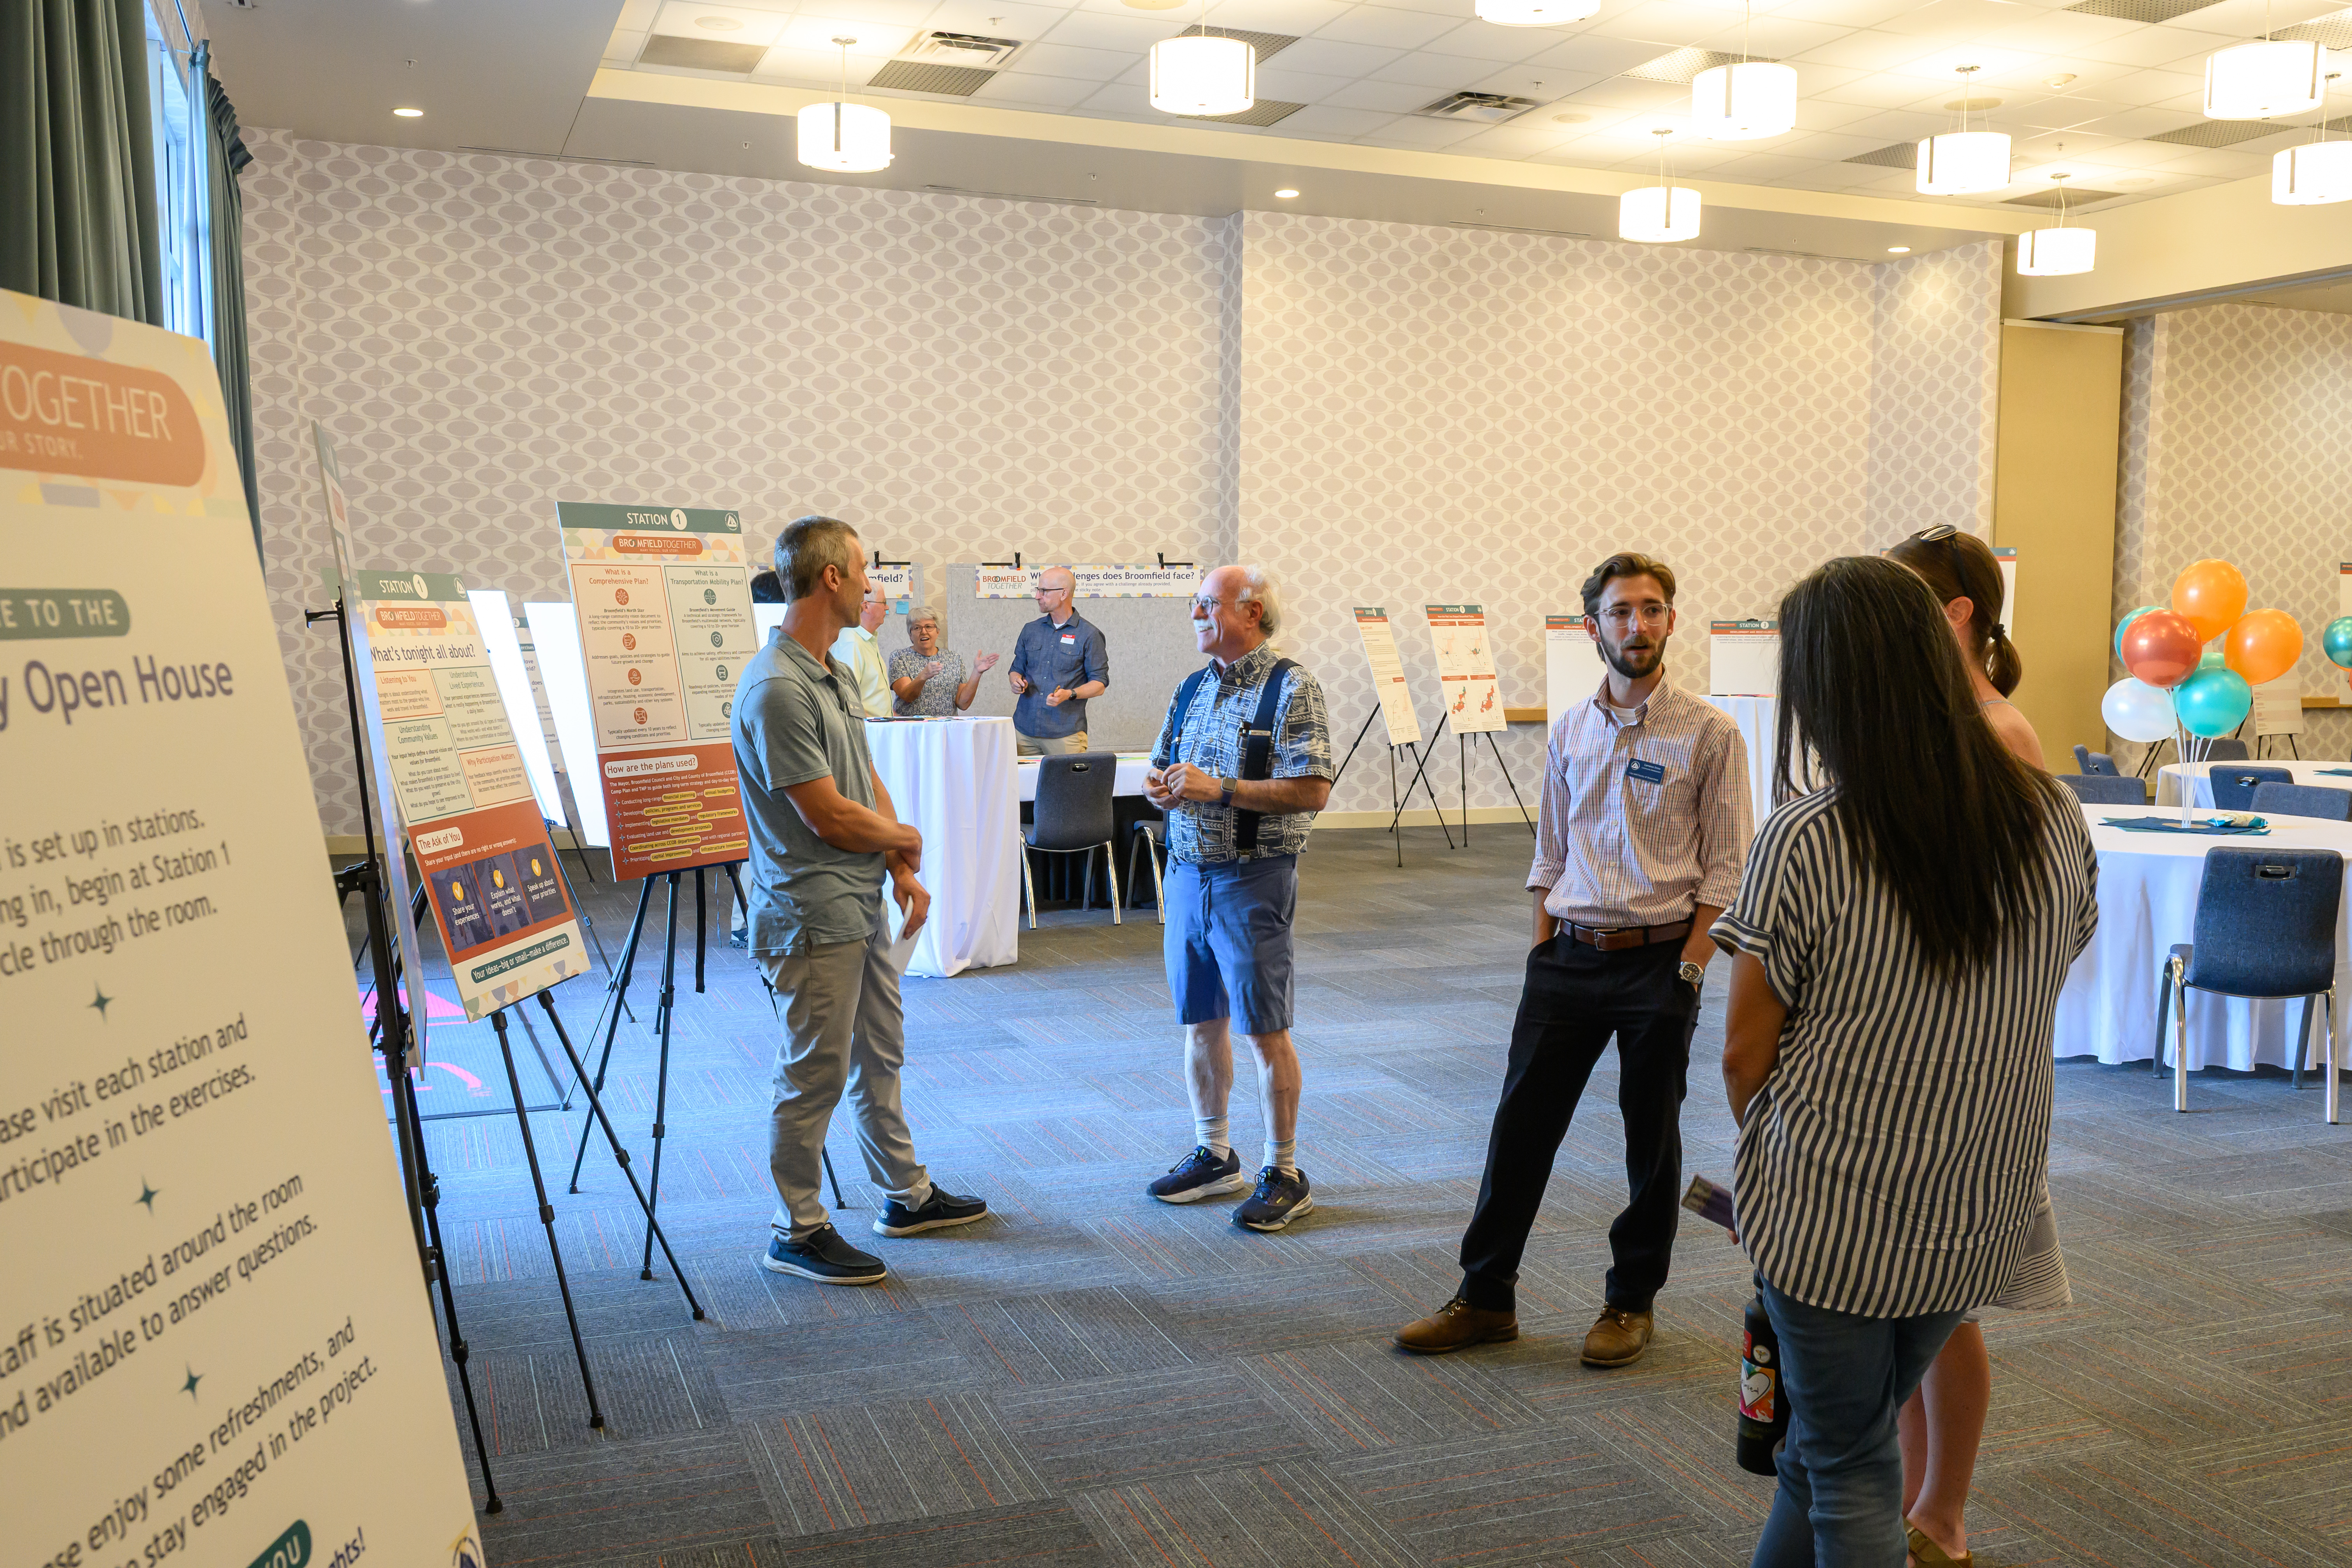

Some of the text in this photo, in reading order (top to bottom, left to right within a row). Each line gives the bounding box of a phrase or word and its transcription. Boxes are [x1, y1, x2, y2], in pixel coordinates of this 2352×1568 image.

[2, 365, 171, 440] OGETHER
[25, 433, 82, 459] STORY.
[627, 513, 681, 525] STATION 1
[379, 580, 413, 593] STATION
[25, 599, 60, 627] TO
[69, 599, 117, 625] THE
[401, 645, 435, 663] tonight
[436, 644, 448, 659] all
[448, 644, 475, 658] about?
[380, 676, 402, 685] Listening
[449, 670, 479, 679] Understanding
[24, 660, 127, 724] Open
[134, 656, 232, 702] House
[460, 681, 485, 690] Experiences
[398, 724, 432, 733] Understanding
[397, 735, 424, 744] Community
[466, 759, 476, 767] Why
[476, 756, 501, 765] Participation
[607, 765, 624, 774] How
[640, 762, 653, 771] the
[655, 761, 674, 772] plans
[676, 758, 695, 767] used?
[6, 809, 204, 868] is set up in stations.
[418, 839, 431, 850] The
[432, 836, 443, 847] Ask
[448, 832, 461, 842] You
[30, 885, 62, 915] in,
[65, 869, 124, 906] begin
[129, 863, 151, 890] at
[152, 849, 217, 883] Station
[220, 841, 230, 865] 1
[527, 882, 539, 893] Speak
[544, 878, 554, 887] about
[490, 886, 515, 900] Explain what
[531, 887, 556, 902] your priorities
[452, 903, 474, 915] Share your
[490, 898, 504, 910] works,
[502, 906, 516, 916] doesn't
[455, 913, 480, 926] experiences
[40, 896, 217, 964] through the room.
[472, 970, 485, 980] Your
[546, 938, 568, 951] difference.
[41, 1013, 247, 1122] visit each station and
[0, 1065, 255, 1202] rticipate in the exercises.
[43, 1317, 65, 1347] is
[70, 1256, 157, 1333] situated
[162, 1215, 226, 1276] around
[229, 1202, 258, 1233] the
[262, 1175, 303, 1213] room
[36, 1330, 135, 1412] available
[140, 1312, 164, 1341] to
[169, 1266, 230, 1324] answer
[238, 1215, 317, 1280] questions.
[88, 1317, 354, 1551] enjoy some refreshments, and
[144, 1357, 376, 1568] stay engaged in the project.
